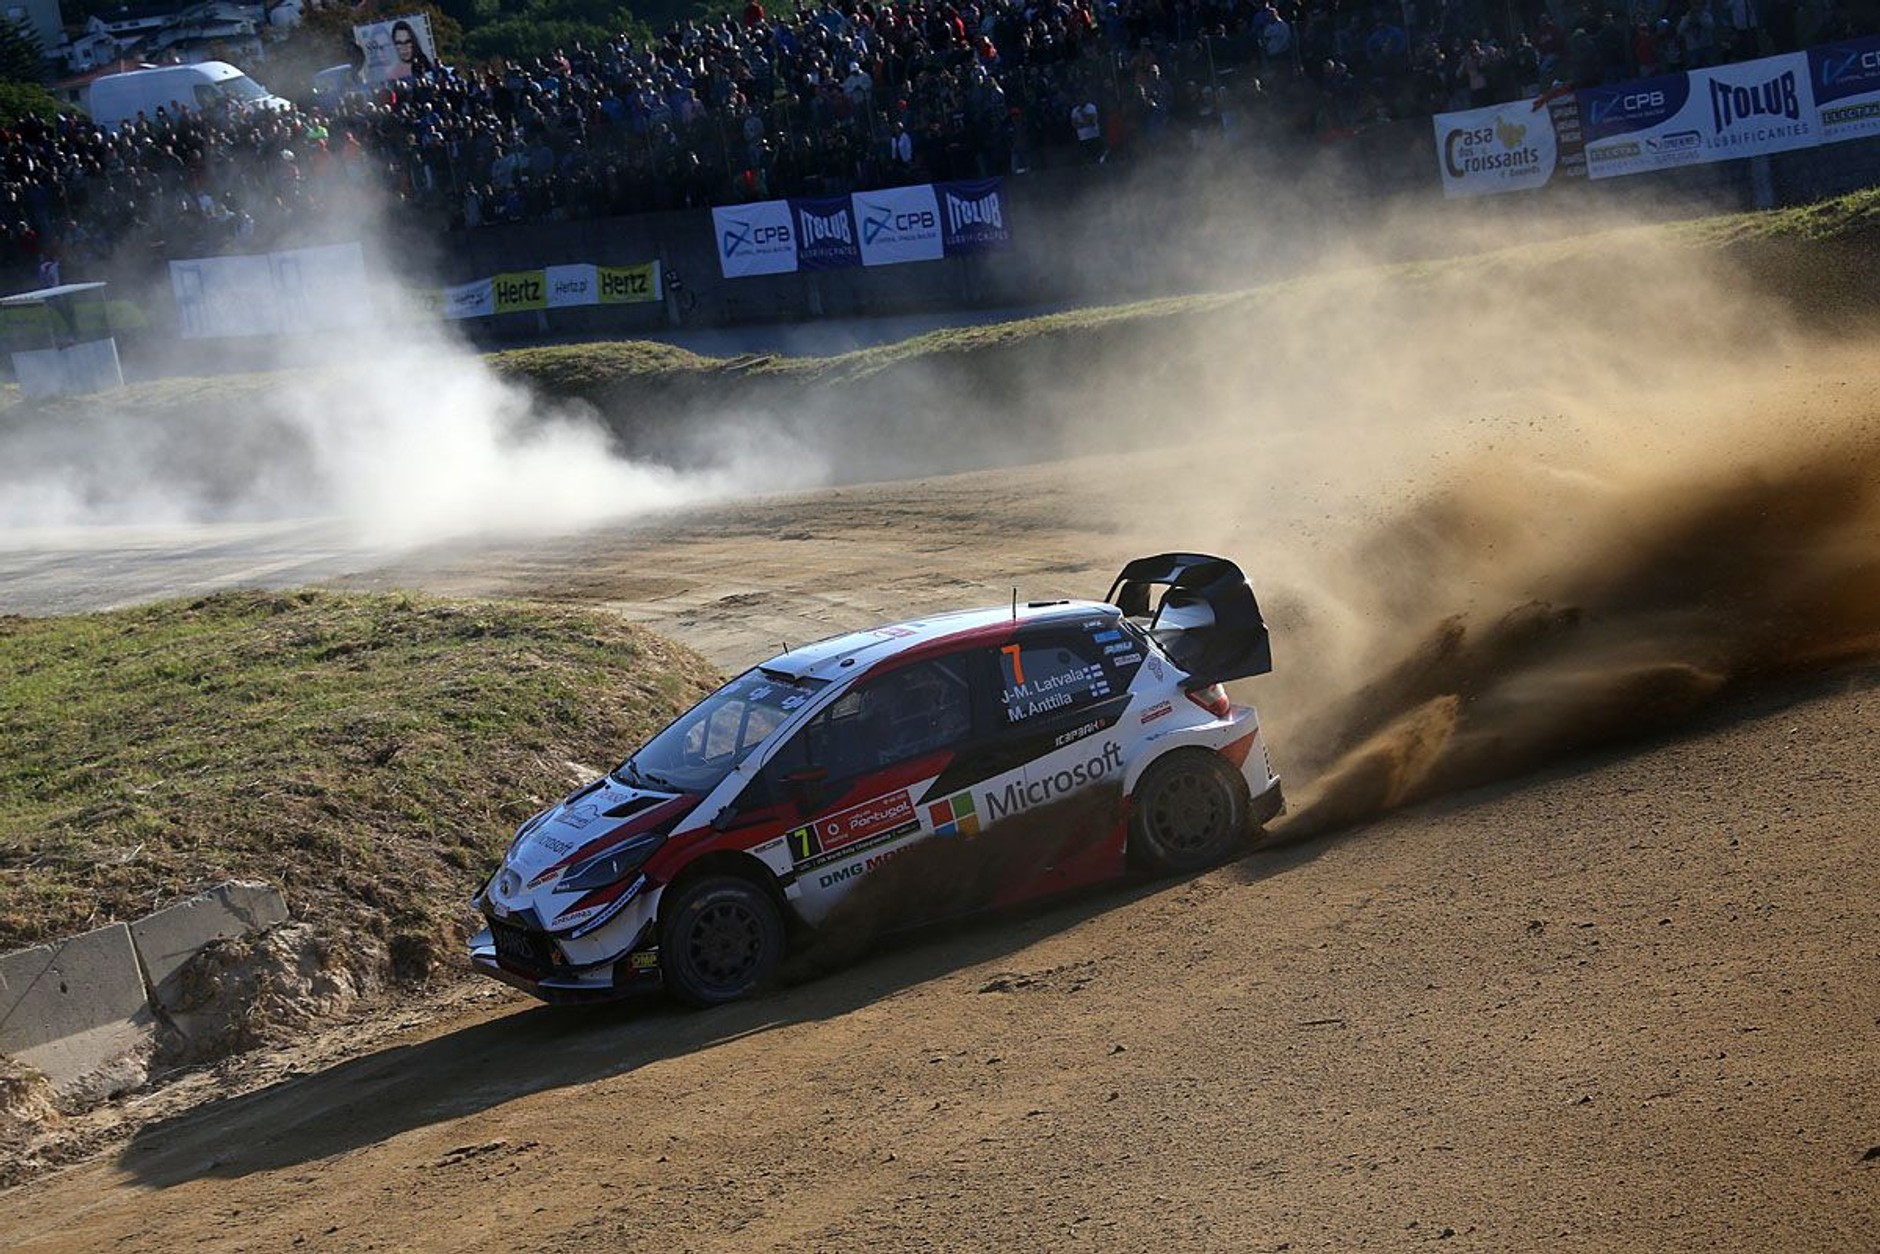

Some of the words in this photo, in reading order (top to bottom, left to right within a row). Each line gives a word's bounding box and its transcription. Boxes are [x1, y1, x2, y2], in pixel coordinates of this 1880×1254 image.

[1623, 90, 1666, 111] CPB
[1708, 70, 1799, 135] ITOLUB
[1707, 122, 1809, 149] LUBRIFICANTES
[895, 211, 935, 231] CPB
[945, 191, 1001, 234] ITOLUB
[753, 225, 791, 244] CPB
[800, 207, 851, 249] ITOLUB
[496, 279, 540, 304] Hertz
[601, 272, 647, 296] Hertz
[1002, 643, 1025, 685] 7
[1001, 684, 1034, 704] J-M.
[1034, 668, 1084, 692] Latvala
[1008, 708, 1027, 723] M.
[1029, 693, 1073, 716] Anttila
[985, 740, 1124, 820] Microsoft
[849, 801, 911, 830] Portugal
[794, 828, 810, 857] 7
[820, 862, 864, 889] DMG
